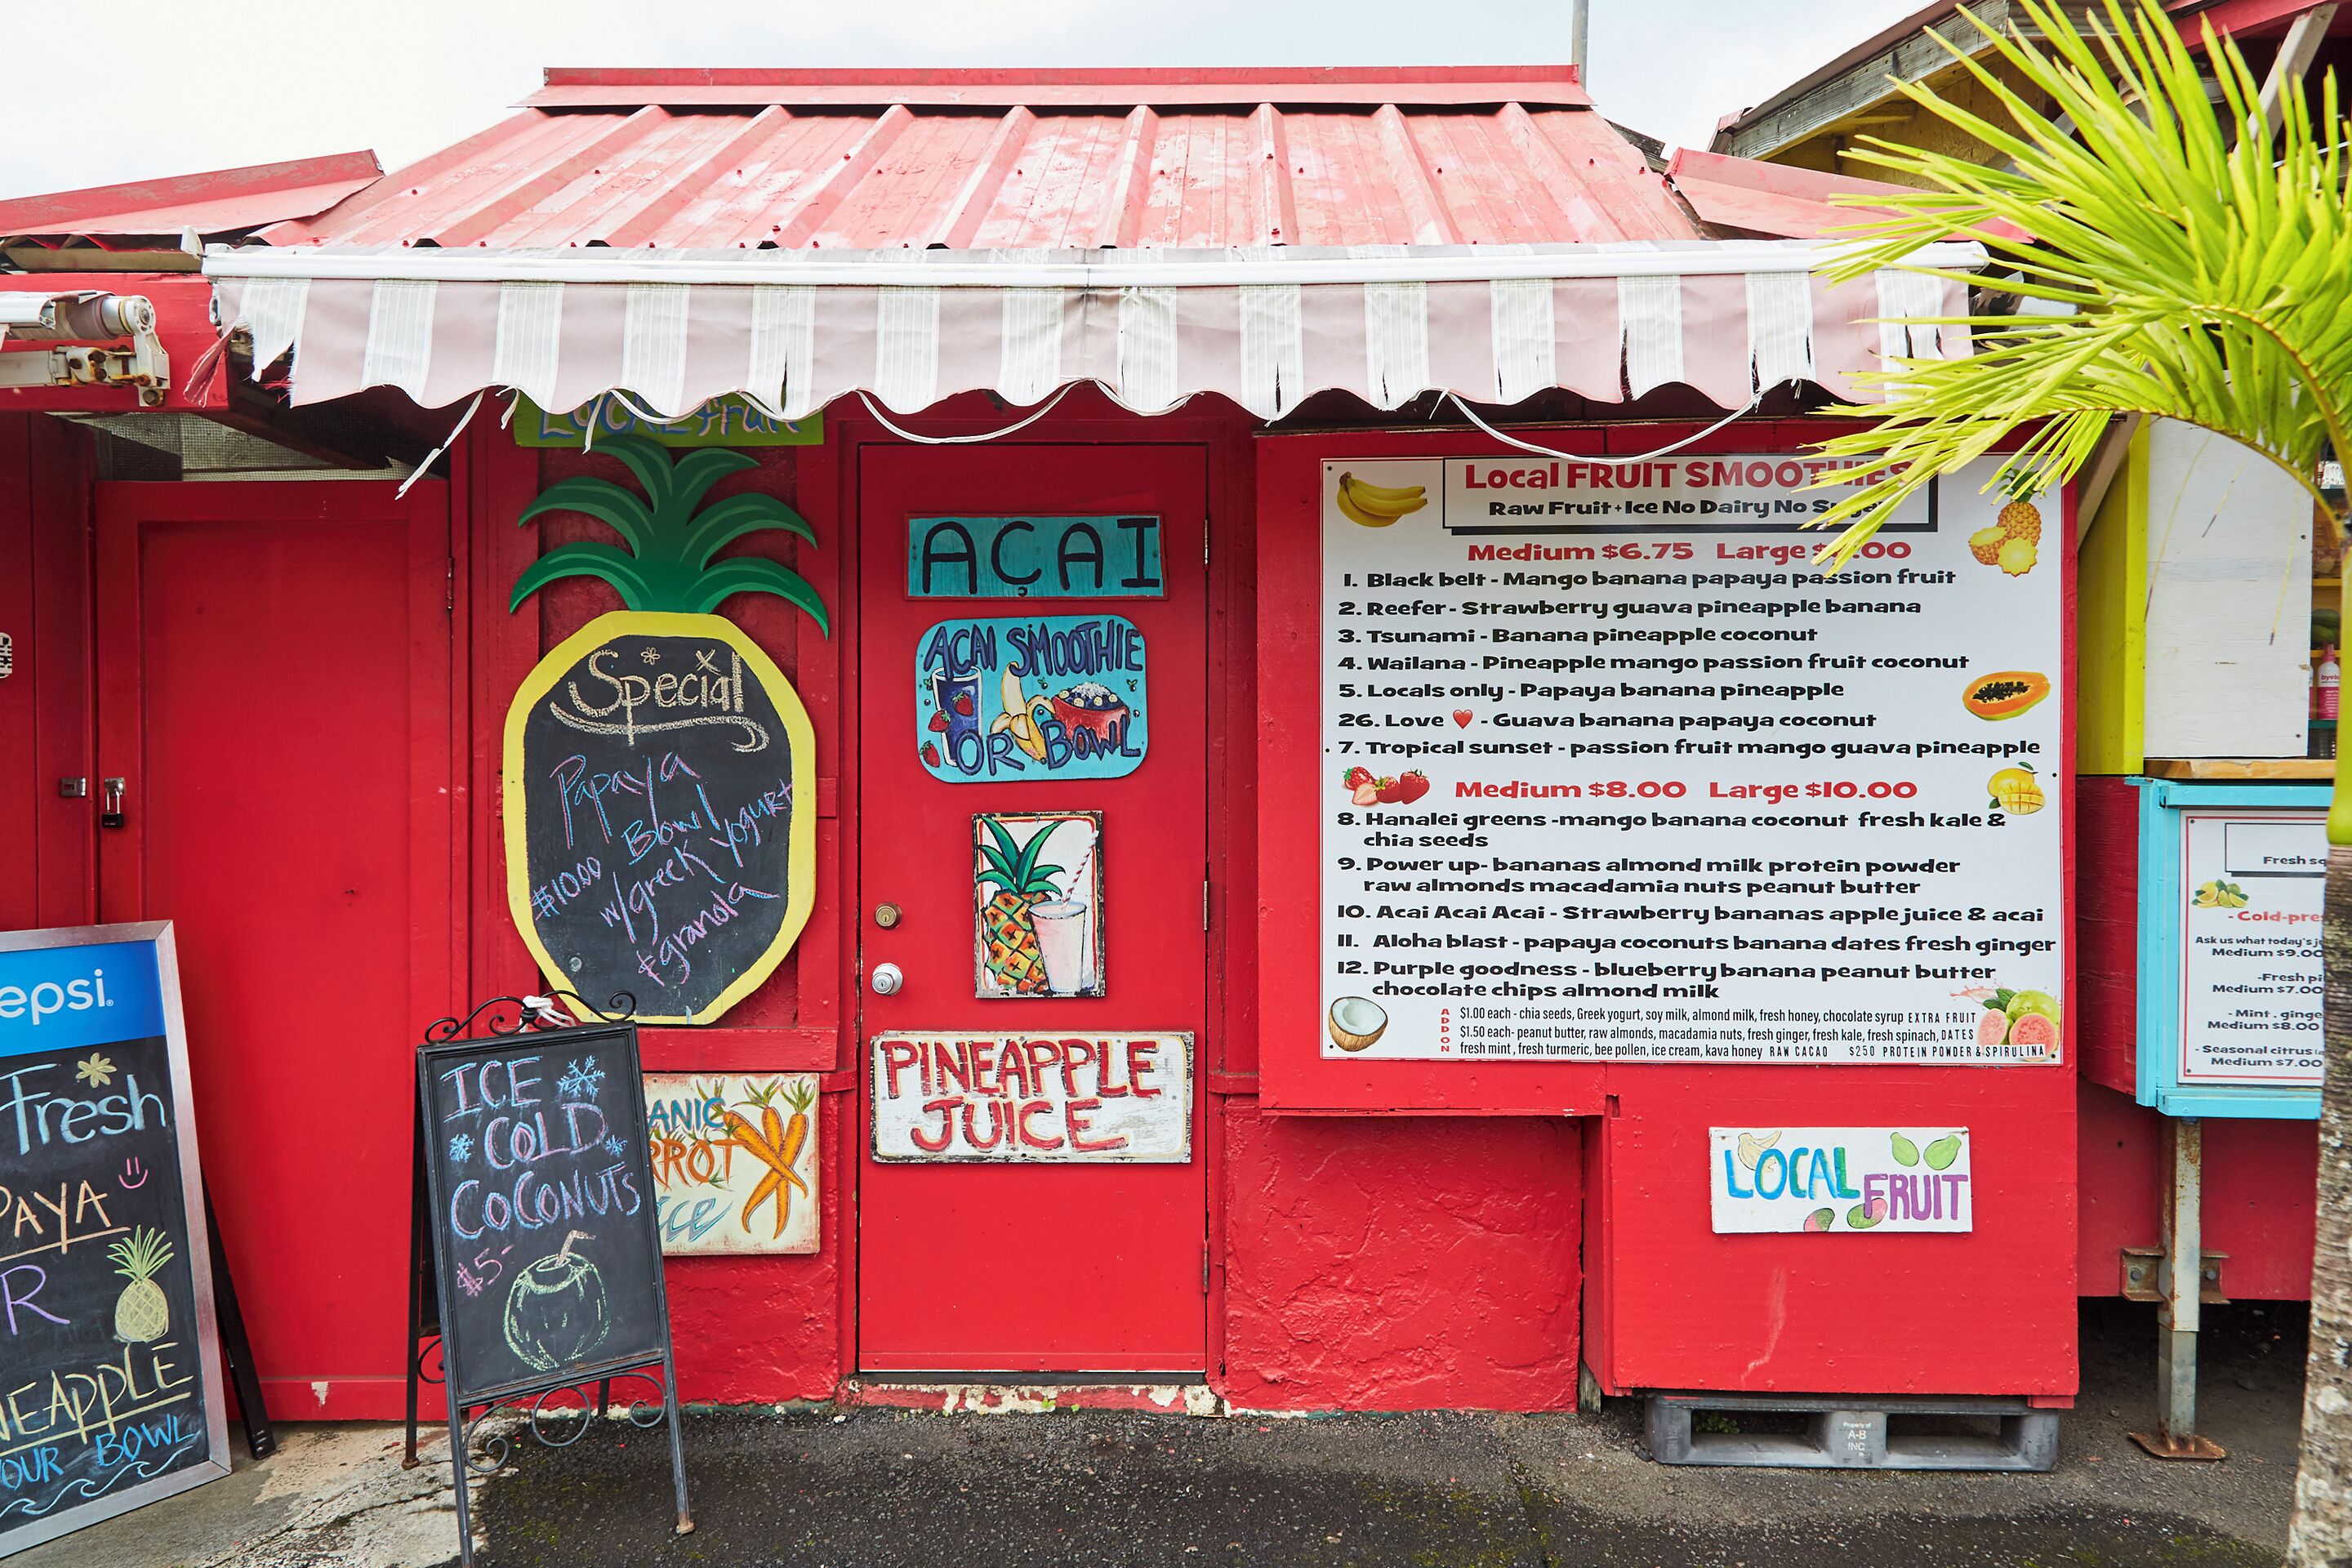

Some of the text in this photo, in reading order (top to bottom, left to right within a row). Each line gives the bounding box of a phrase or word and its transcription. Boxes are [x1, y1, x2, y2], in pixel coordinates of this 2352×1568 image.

[1465, 461, 1560, 490] Local
[1568, 461, 1677, 489] FRUIT
[1489, 501, 1545, 516] Raw
[1624, 500, 1659, 514] Ice
[1662, 500, 1696, 514] No
[1699, 499, 1770, 519] Dairy
[1774, 499, 1808, 514] No
[1468, 542, 1912, 566] Medium $6.75 Large $.00
[1367, 572, 1435, 588] Black
[1438, 572, 1487, 588] belt
[1503, 572, 1588, 591] Mango
[1592, 570, 1687, 586] banana
[1691, 572, 1788, 590] papaya
[1792, 570, 1892, 589] passion
[1896, 568, 1957, 585] fruit
[1461, 599, 1609, 620] Strawberry
[1612, 603, 1693, 620] guava
[1697, 599, 1821, 618] pineapple
[1824, 598, 1922, 614] banana
[1365, 629, 1476, 644] Tsunami
[1492, 628, 1588, 644] Banana
[1592, 626, 1717, 647] pineapple
[1720, 627, 1819, 642] coconut
[1005, 618, 1144, 678] SMOOTHIE
[1366, 656, 1466, 671] Wailana
[1482, 654, 1606, 674] Pineapple
[1610, 657, 1699, 675] mango
[1703, 655, 1803, 674] passion
[1806, 653, 1867, 670] fruit
[1870, 655, 1970, 669] coconut
[568, 648, 745, 750] Special
[1367, 683, 1446, 698] Locals
[1449, 683, 1503, 703] only
[1520, 683, 1616, 702] Papaya
[1619, 682, 1716, 697] banana
[1720, 682, 1844, 702] pineapple
[1385, 714, 1445, 728] Love
[1492, 712, 1575, 728] Guava
[1579, 712, 1674, 728] banana
[1678, 715, 1775, 733] papaya
[1779, 714, 1878, 728] coconut
[955, 714, 1143, 777] OR BOWL
[1365, 740, 1464, 759] Tropical
[1468, 741, 1553, 755] sunset
[1570, 740, 1669, 759] passion
[1673, 737, 1733, 755] fruit
[1737, 742, 1827, 760] mango
[1830, 742, 1911, 760] guava
[1915, 740, 2041, 759] pineapple
[550, 751, 702, 851] Papaya
[1454, 780, 1918, 805] Medium $8.00 Large $10.00
[621, 783, 722, 866] Bowl
[1363, 831, 1489, 848] chia seeds
[2263, 855, 2306, 865] Fresh
[2237, 911, 2324, 925] Cold-pre
[2195, 936, 2218, 944] Ask
[2235, 935, 2266, 945] what
[2267, 937, 2313, 948] today's
[2212, 947, 2323, 958] Medium $9.00
[1374, 960, 1455, 980] Purple
[1459, 961, 1578, 981] goodness
[1593, 961, 1717, 982] blueberry
[1720, 962, 1816, 978] banana
[1820, 965, 1911, 982] peanut
[1914, 964, 1997, 979] butter
[2212, 984, 2323, 995] Medium $7.00
[1459, 1006, 1976, 1026] $1.00 each chia seeds, Greek yogurt, soy milk, almond milk, fresh honey, chocolate syrup EXTRA FRUIT
[2234, 1009, 2271, 1018] Mint
[2207, 1020, 2320, 1031] Medium $8.00
[2202, 1045, 2313, 1056] Seasonal citrus
[880, 1037, 1162, 1100] PINEAPPLE
[2210, 1057, 2323, 1068] Medium $7.00
[439, 1054, 544, 1123] ICE
[0, 1062, 167, 1156] Fresh
[910, 1095, 1130, 1154] JUICE
[483, 1102, 609, 1170] COLD
[1724, 1146, 1969, 1221] LOCAL FRUIT
[450, 1160, 641, 1241] COCONUTS
[95, 1413, 195, 1468] BOWL
[1847, 1429, 1867, 1440] A-B
[1847, 1441, 1865, 1451] INC
